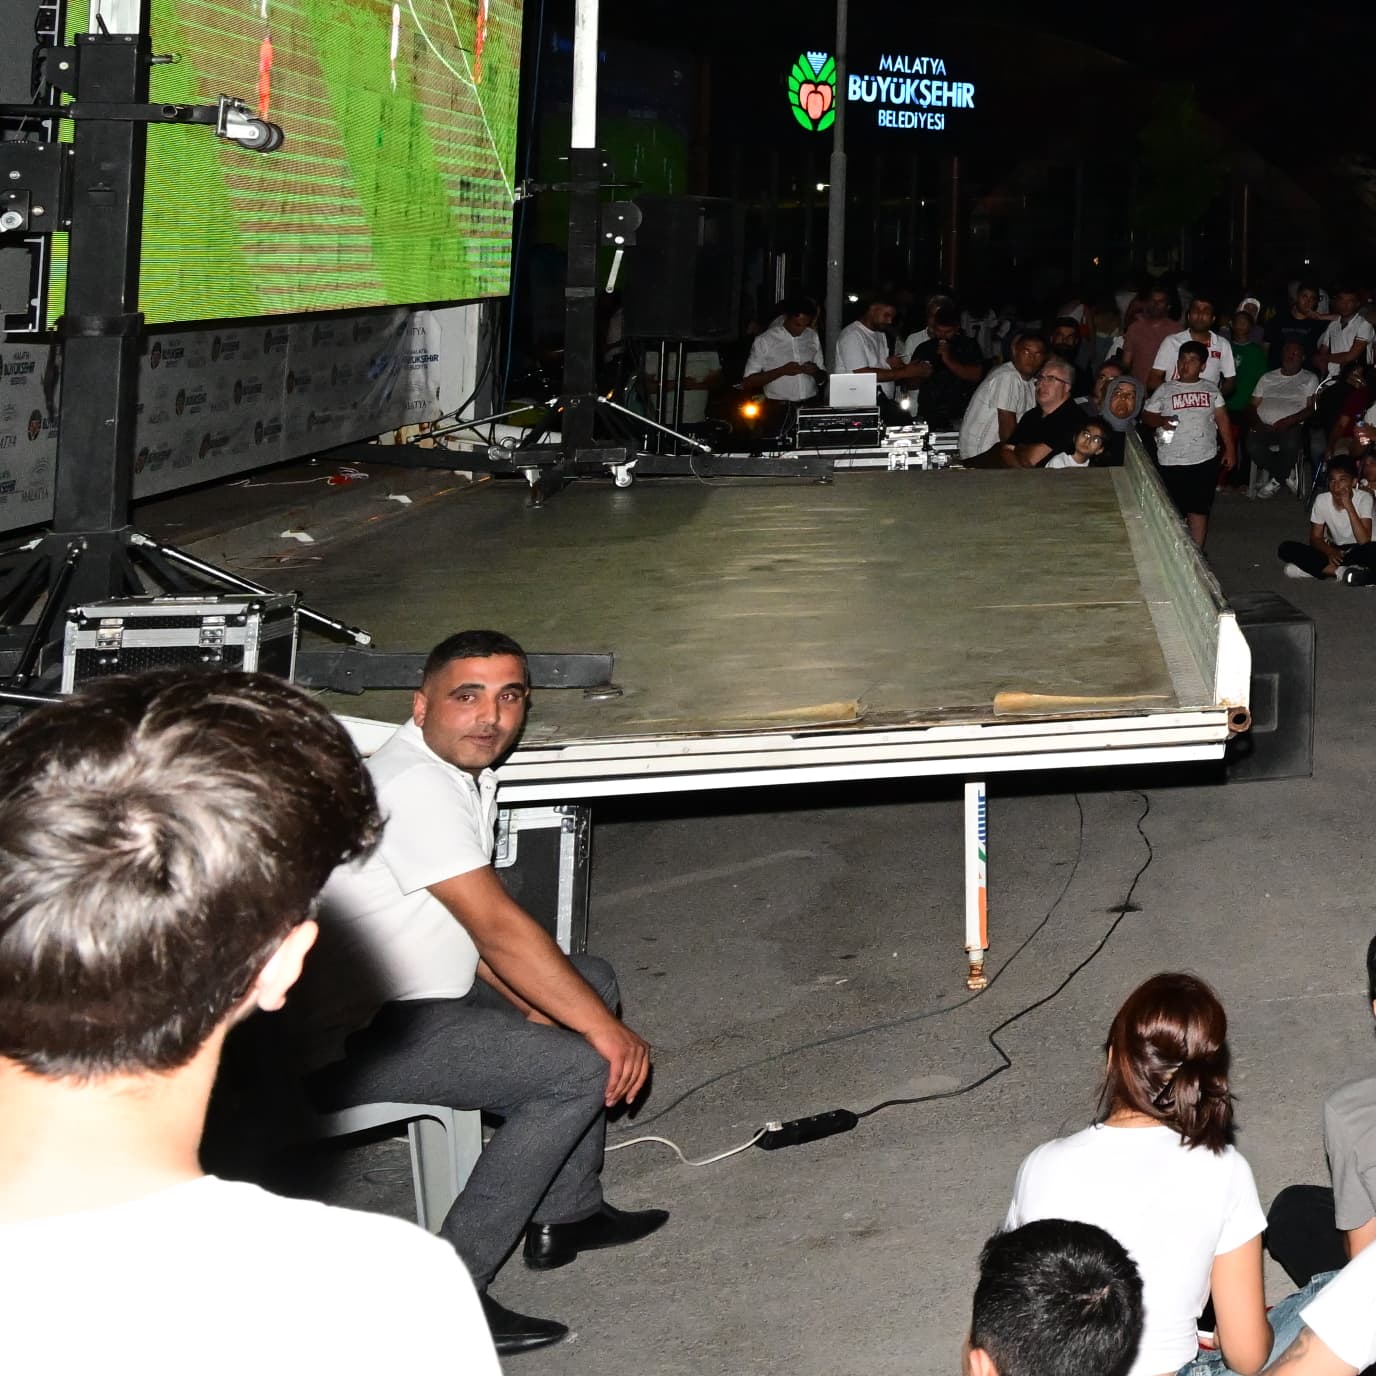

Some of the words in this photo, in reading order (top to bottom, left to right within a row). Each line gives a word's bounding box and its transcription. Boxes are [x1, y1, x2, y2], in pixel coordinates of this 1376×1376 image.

[879, 54, 947, 75] MALATYA
[848, 75, 975, 109] BÜYÜKŞEHİR
[878, 110, 945, 130] BELEDİYESİ
[1172, 393, 1210, 409] MARVEL
